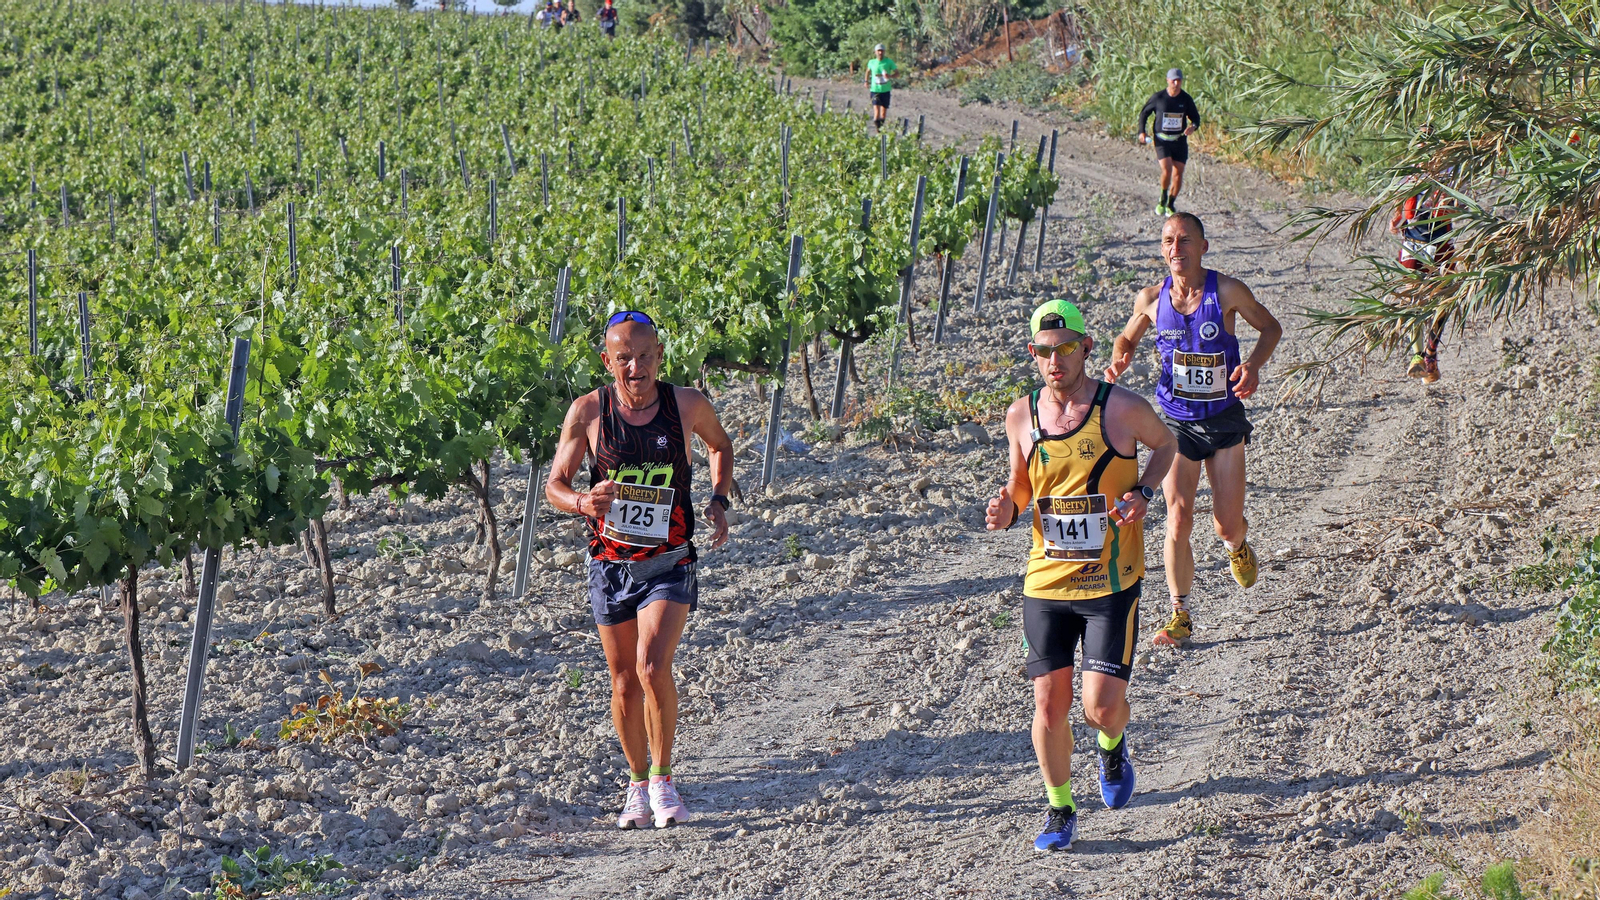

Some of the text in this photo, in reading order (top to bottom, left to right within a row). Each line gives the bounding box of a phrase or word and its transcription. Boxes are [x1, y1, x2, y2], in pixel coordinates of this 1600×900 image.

[1186, 354, 1213, 365] Sherry
[1185, 369, 1214, 386] 158
[641, 461, 674, 471] Molina
[623, 485, 657, 500] Sherry
[1055, 499, 1087, 513] Sherry
[619, 503, 655, 528] 125
[1055, 517, 1089, 540] 141
[1070, 574, 1108, 583] HYUNDAI
[1091, 664, 1116, 674] JACARSA
[1095, 660, 1121, 669] HYUNDAI
